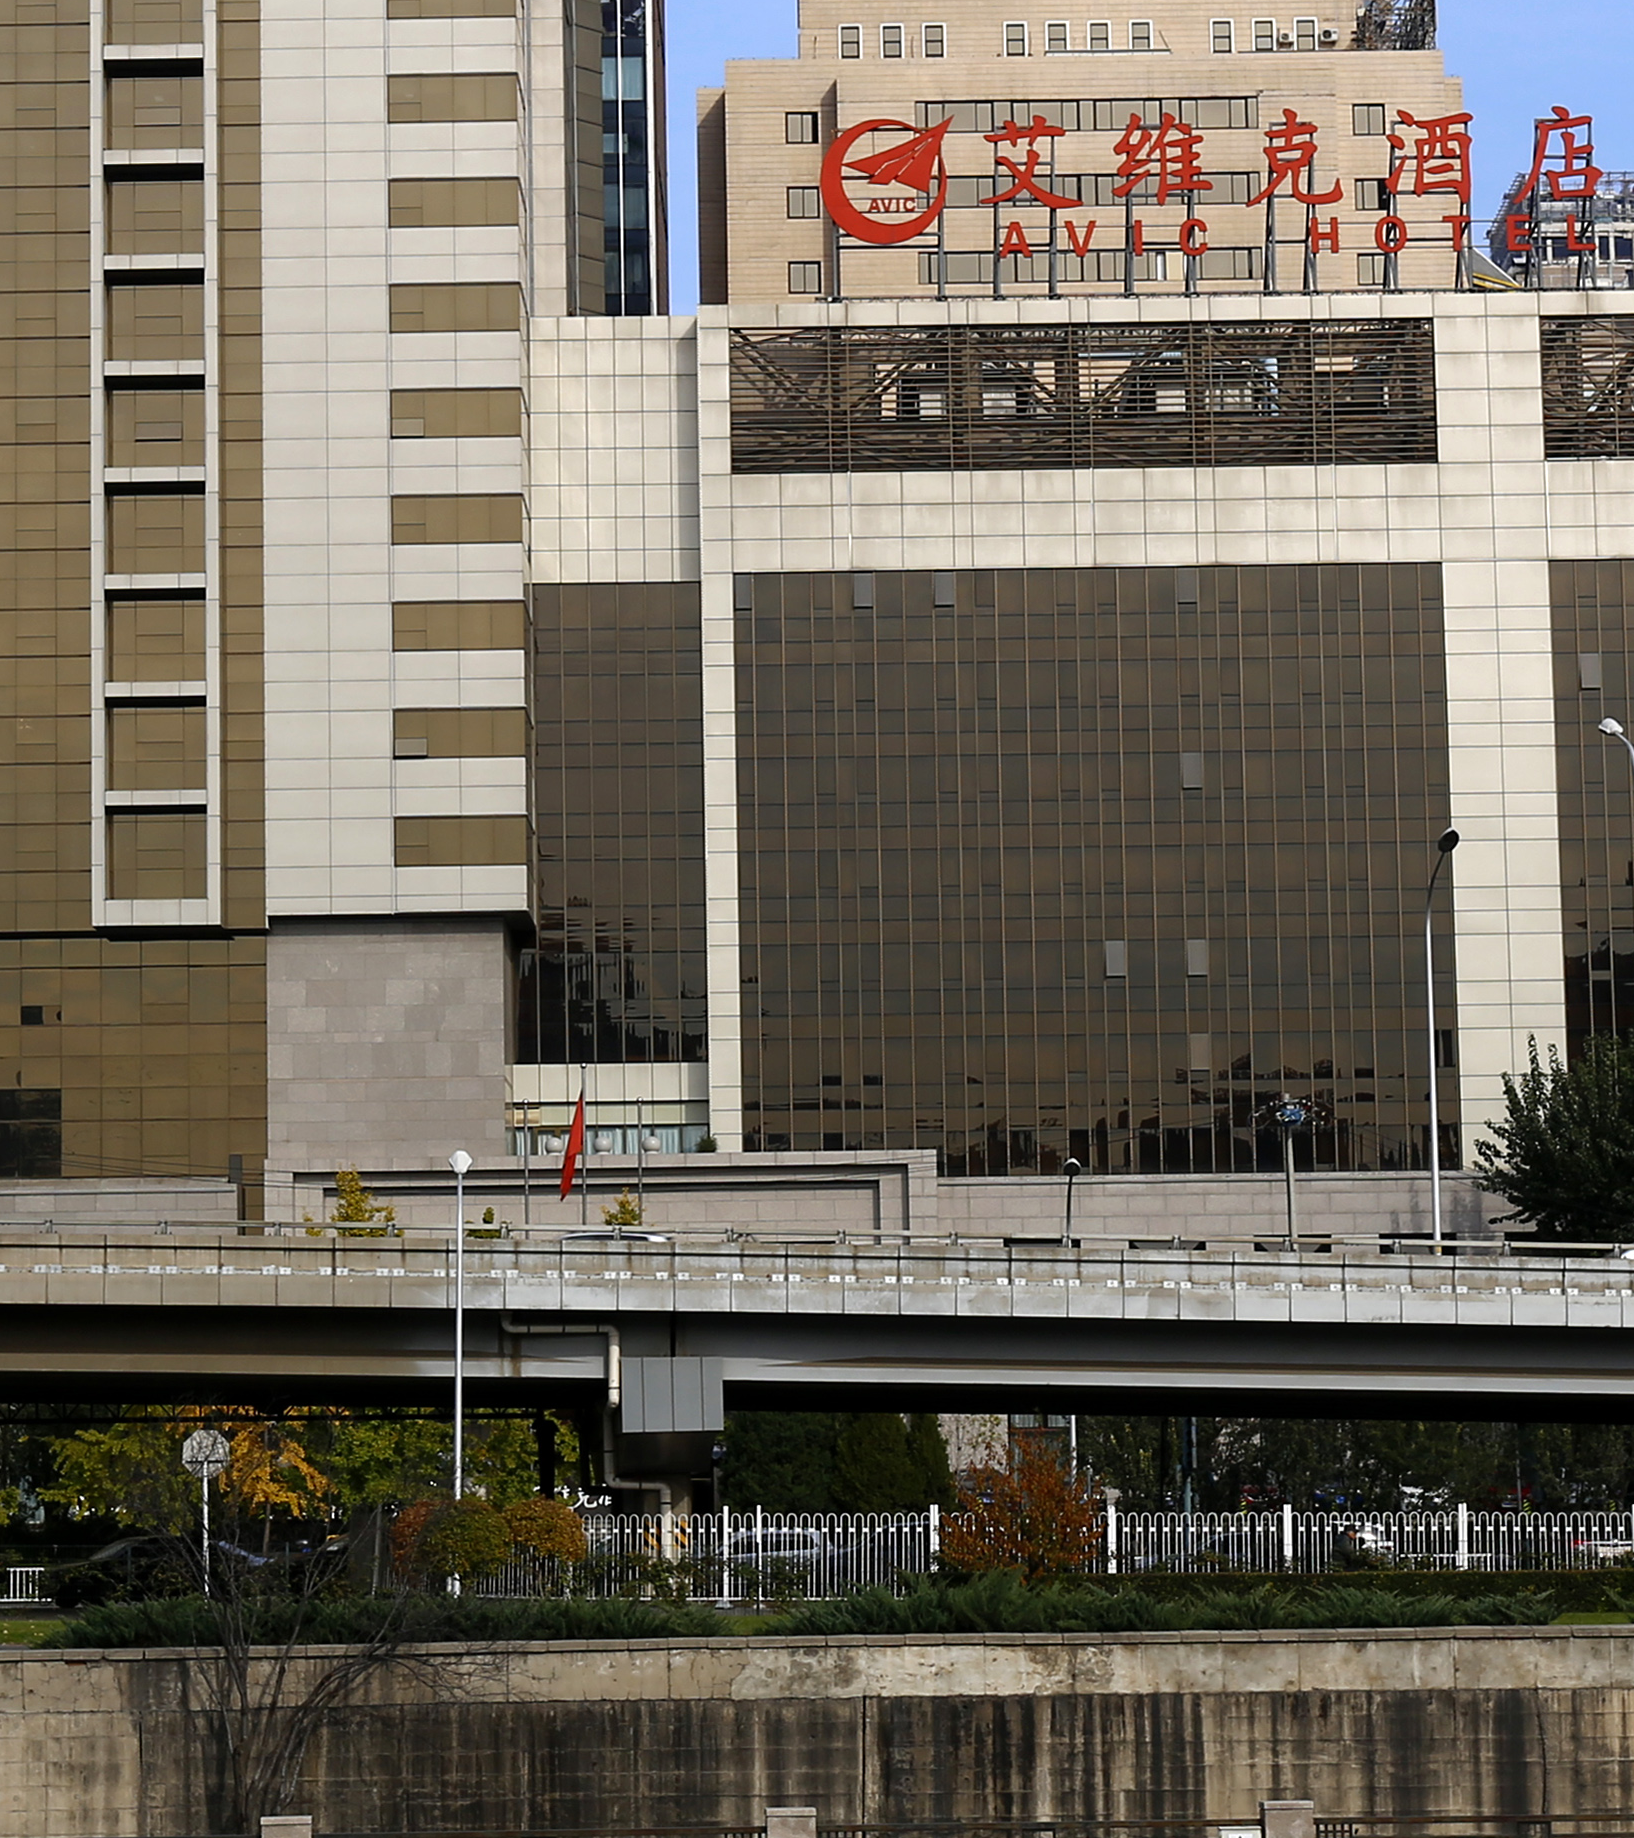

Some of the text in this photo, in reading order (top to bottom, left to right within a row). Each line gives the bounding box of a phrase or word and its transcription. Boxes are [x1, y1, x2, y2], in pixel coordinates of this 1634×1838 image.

[979, 105, 1604, 209] 艾维克酒店
[868, 197, 917, 213] AVIC
[999, 214, 1597, 259] AVIC HOTEL
